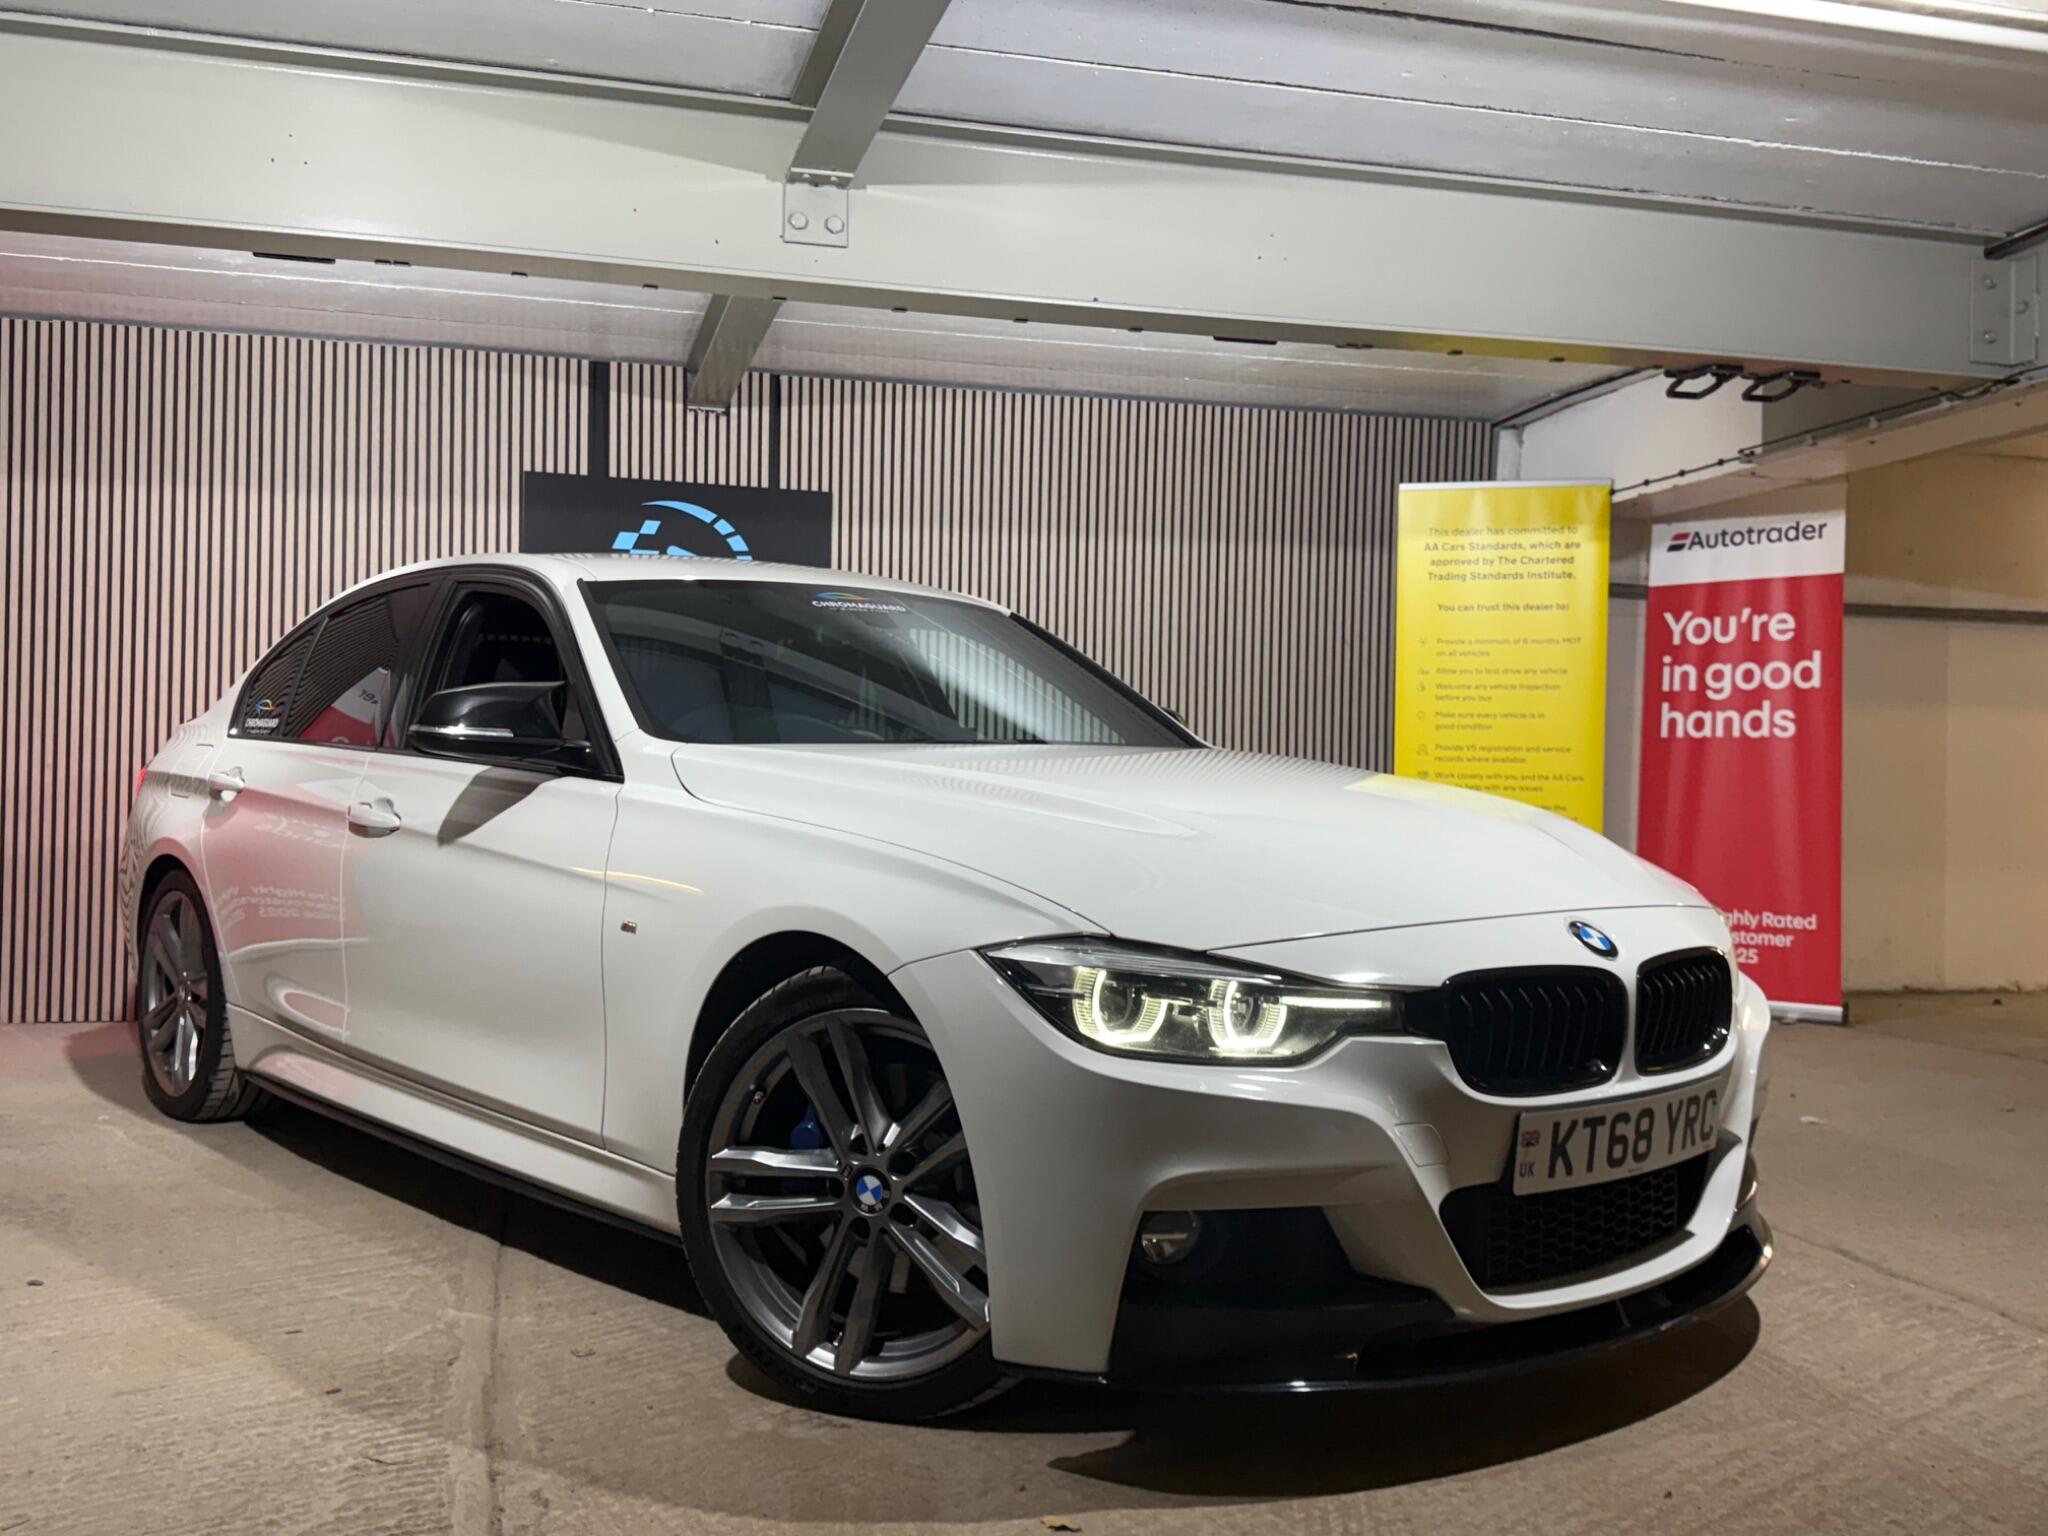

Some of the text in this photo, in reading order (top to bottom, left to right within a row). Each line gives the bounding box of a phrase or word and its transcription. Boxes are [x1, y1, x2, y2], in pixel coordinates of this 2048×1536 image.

[1428, 526, 1578, 536] This dealer has committed to
[1687, 520, 1828, 551] Autotrader
[1424, 541, 1582, 552] AA Cars Standards, which are
[1430, 556, 1575, 568] approved by The Chartered
[1428, 571, 1576, 582] Trading Standards Institute.
[1438, 604, 1456, 612] You
[1477, 604, 1500, 612] trust
[1522, 603, 1554, 611] dealer
[1662, 607, 1797, 646] You're
[1661, 649, 1822, 701] in good
[1660, 699, 1796, 739] hands
[1762, 911, 1818, 931] Rated
[1731, 930, 1794, 948] stomer
[1736, 948, 1759, 965] 25
[1547, 1088, 1718, 1179] KT68 YRC
[1519, 1160, 1536, 1179] UK
